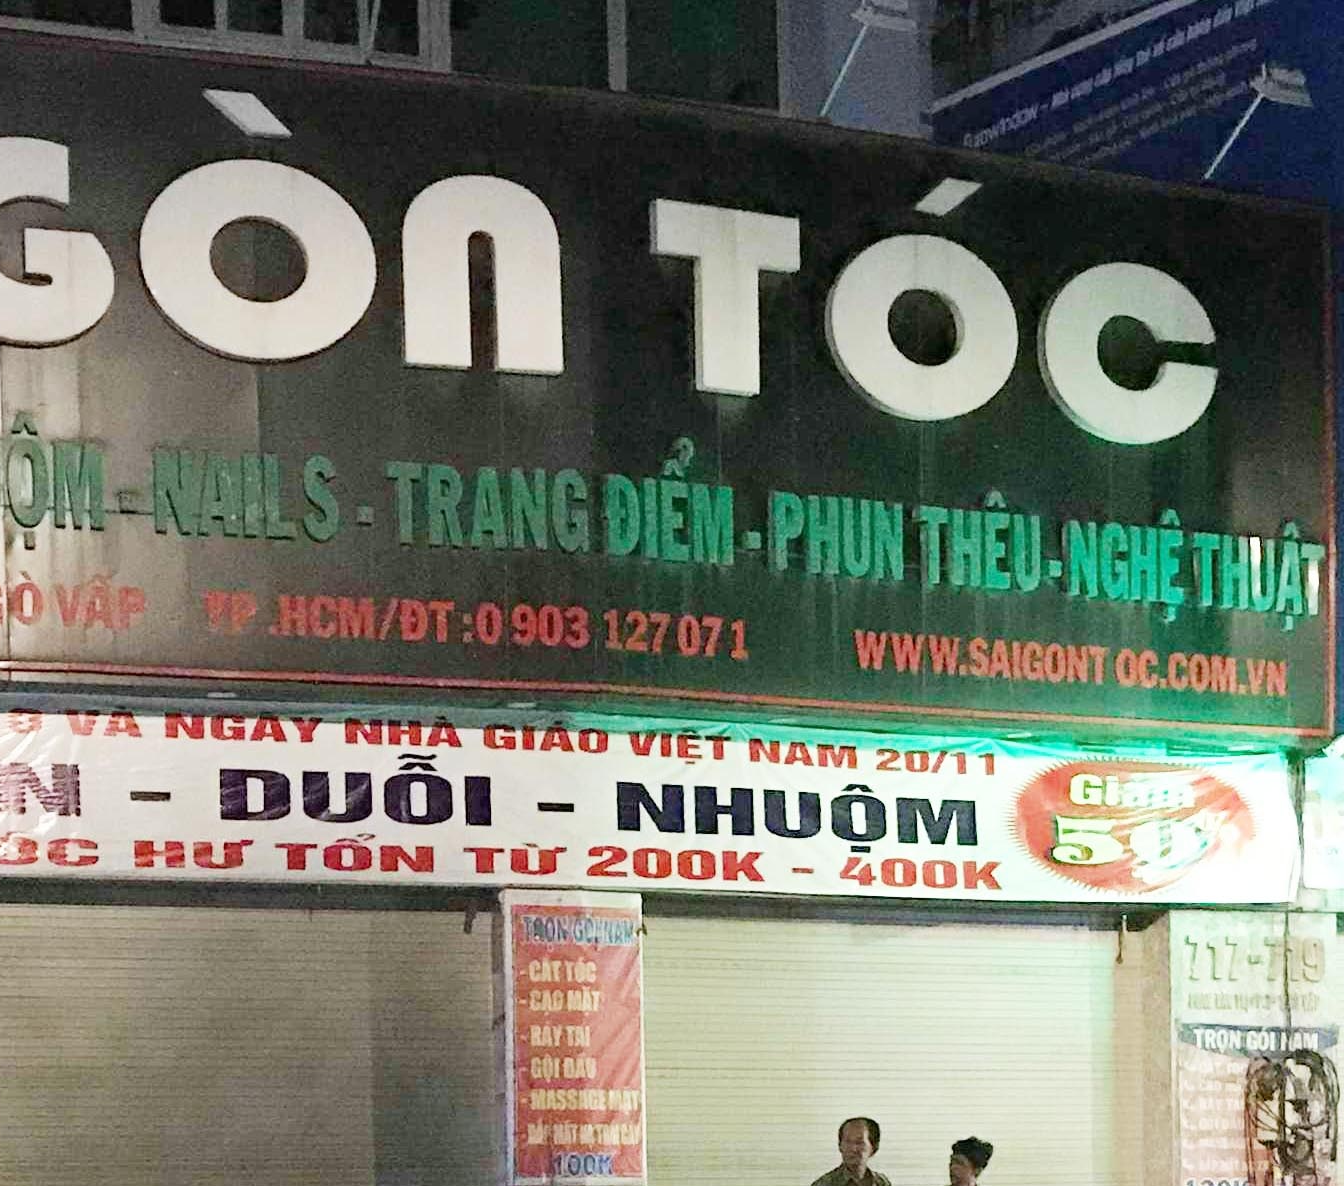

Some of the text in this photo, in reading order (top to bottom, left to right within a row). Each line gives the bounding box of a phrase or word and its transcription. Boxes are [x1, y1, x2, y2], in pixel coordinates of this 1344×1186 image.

[650, 177, 1218, 446] TÓC
[152, 449, 344, 544] NAILS
[384, 459, 592, 555] TRANG
[601, 436, 735, 566] ĐIỂM
[768, 490, 904, 582] PHUN
[913, 490, 1041, 592] THÊU
[1062, 508, 1184, 623] NGHỆ
[1192, 520, 1325, 631] THUẬT
[219, 752, 493, 827] DUỖI
[615, 780, 979, 854] NHUỘM
[628, 730, 732, 765] VIỆT
[748, 737, 858, 769] NAM
[875, 747, 996, 777] 20/11
[274, 832, 435, 873] TỔN
[462, 841, 568, 876] TỪ
[586, 844, 766, 883] 200K
[837, 855, 1004, 892] 400K
